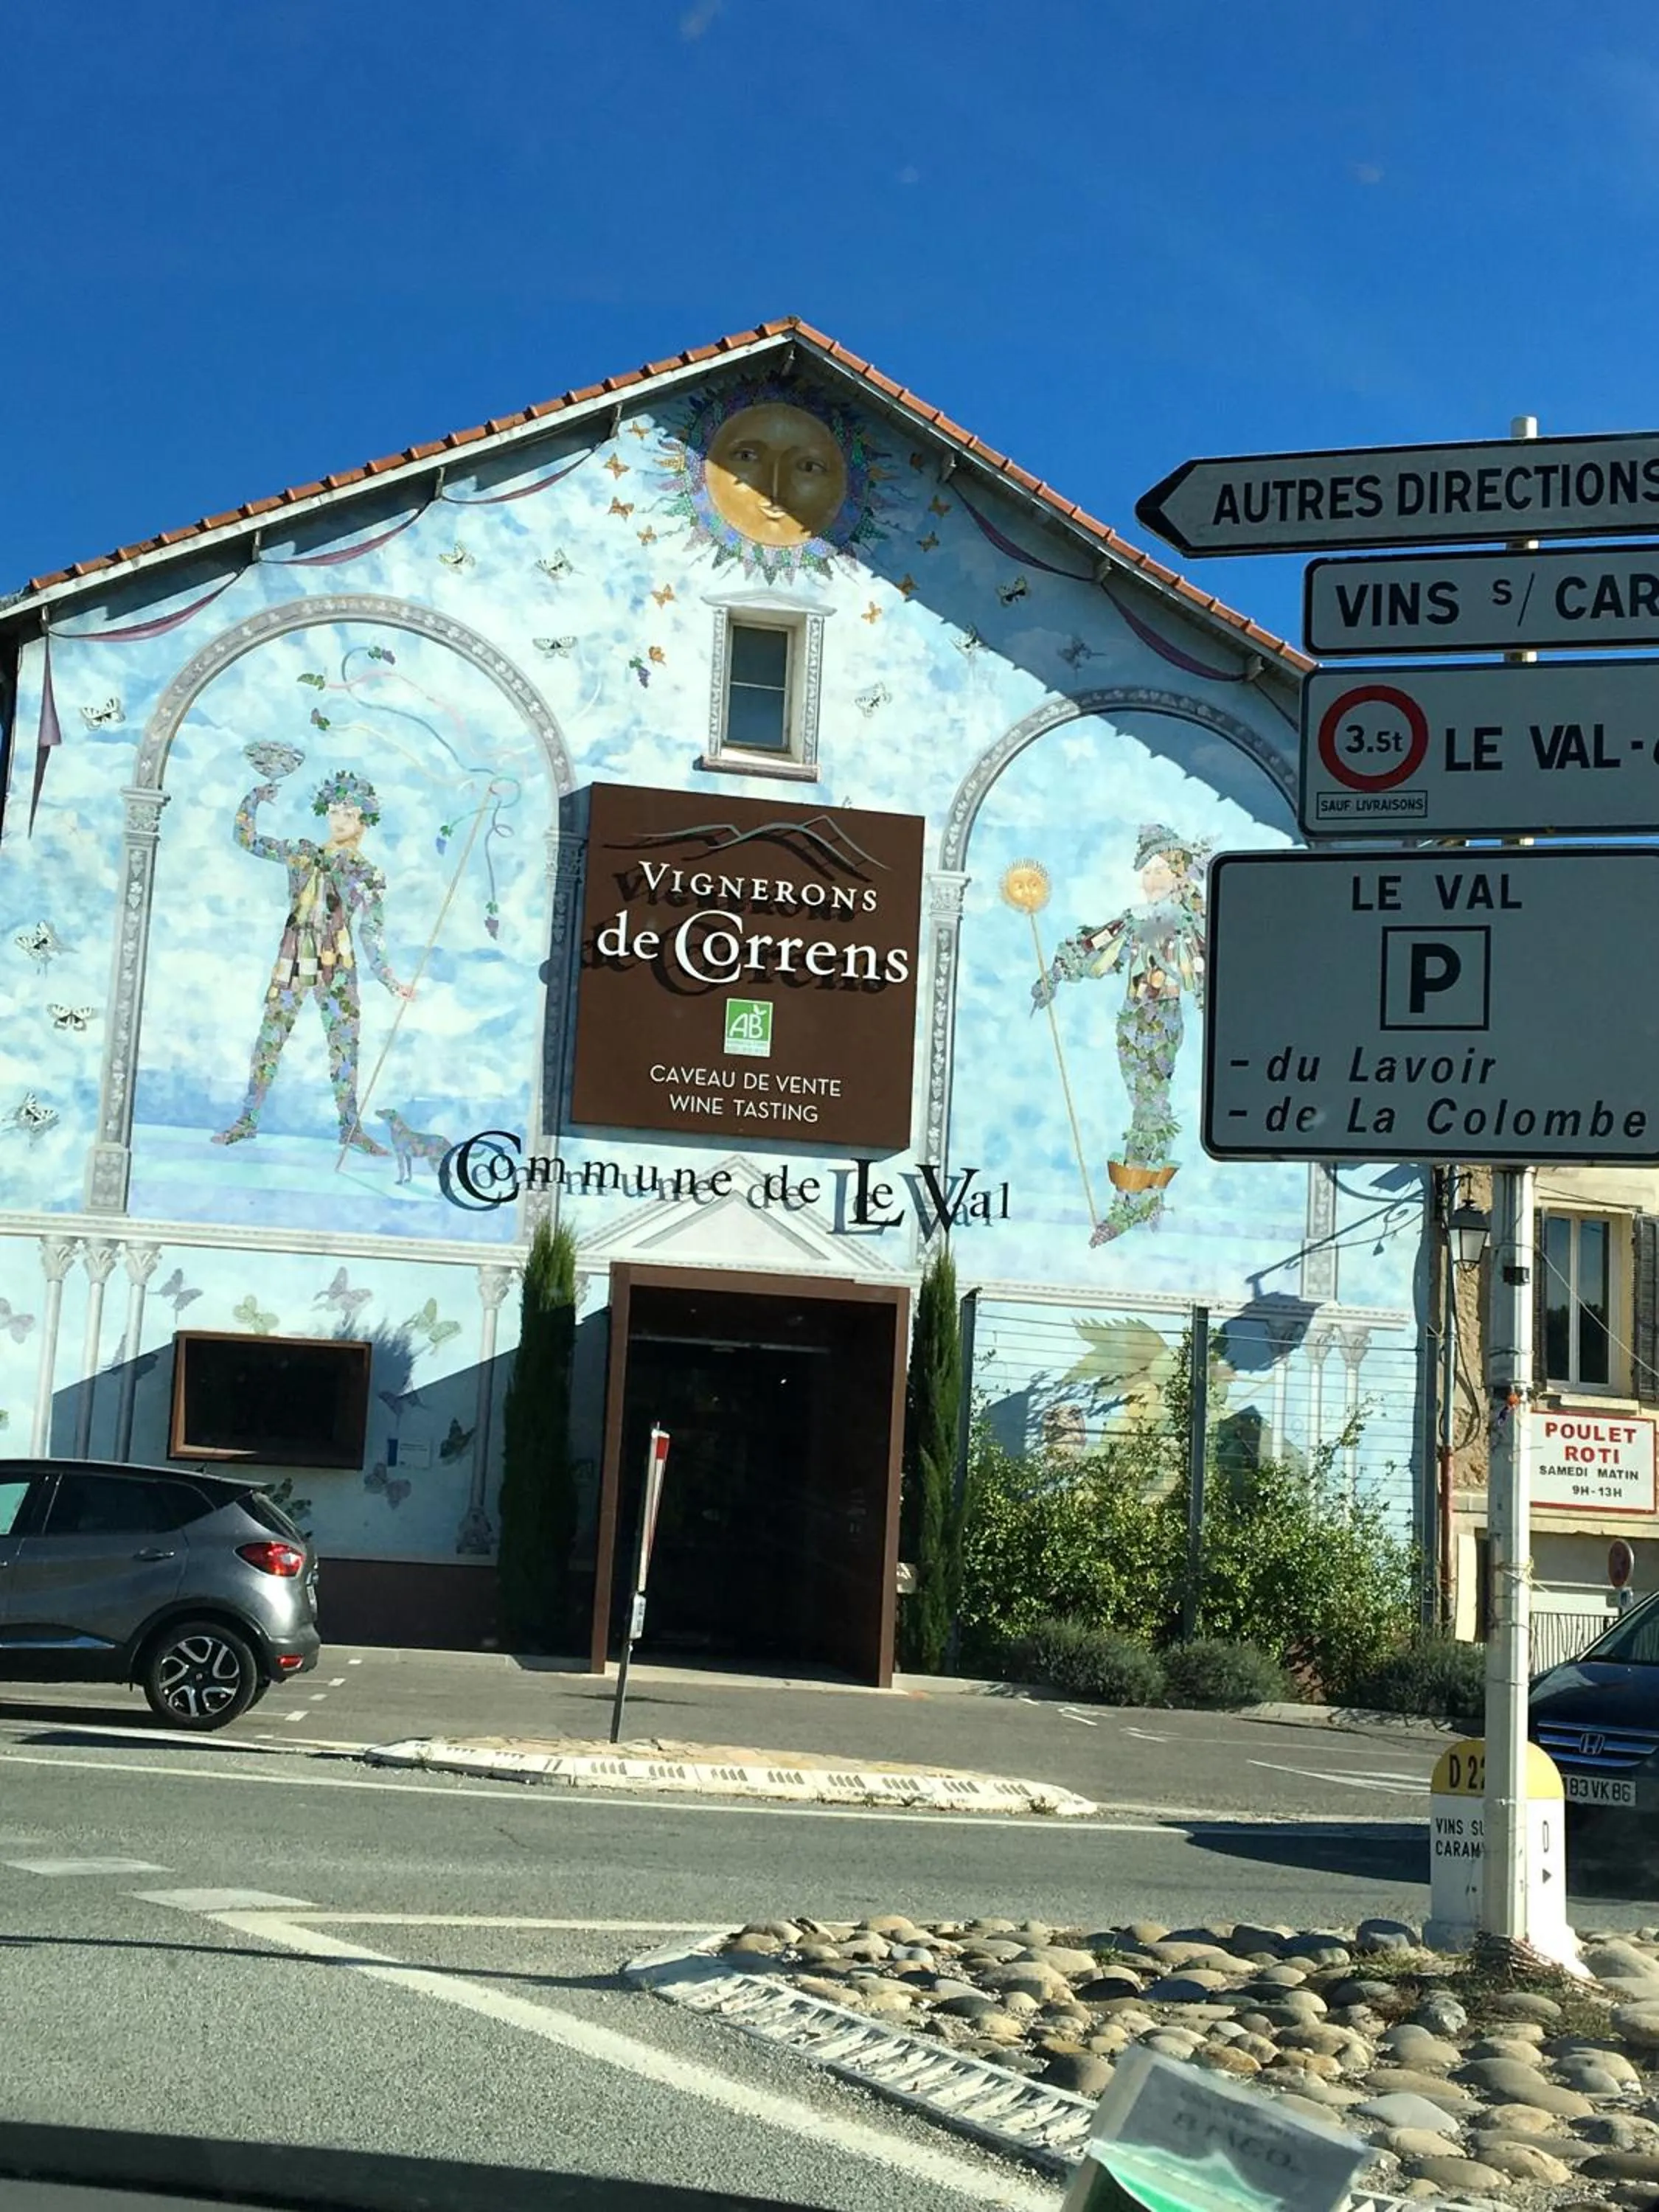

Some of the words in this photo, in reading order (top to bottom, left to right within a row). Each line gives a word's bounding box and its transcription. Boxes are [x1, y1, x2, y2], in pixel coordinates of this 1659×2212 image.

[1213, 475, 1382, 525] AUTRES
[1398, 459, 1659, 515] DIRECTIONS
[1336, 581, 1459, 627] VINS
[1345, 723, 1403, 754] 3.5t
[1444, 726, 1503, 772] LE
[1321, 799, 1352, 812] SAUF
[1356, 798, 1424, 812] LIVRAISONS
[638, 860, 878, 911] VIGNERONS
[1352, 875, 1402, 911] LE
[1435, 873, 1523, 910] VAL
[597, 909, 660, 961] de
[675, 909, 909, 984] Correns
[1409, 942, 1461, 1014] P
[728, 1012, 763, 1039] AB
[650, 1065, 736, 1089] CAVEAU
[743, 1073, 770, 1092] DE
[775, 1075, 842, 1098] VENTE
[1266, 1046, 1321, 1083] du
[1349, 1046, 1497, 1085] Lavoir
[669, 1094, 723, 1116] WINE
[733, 1099, 818, 1123] TASTING
[1266, 1096, 1317, 1133] de
[1347, 1097, 1396, 1134] La
[1427, 1098, 1647, 1138] Colombe
[456, 1130, 732, 1205] Commune
[763, 1164, 821, 1204] de
[849, 1157, 903, 1225] Le
[914, 1163, 1010, 1234] Val
[1545, 1422, 1637, 1444] POULET
[1539, 1465, 1587, 1477] SAMEDI
[1597, 1468, 1639, 1481] MATIN
[1564, 1446, 1620, 1464] ROTI
[1449, 1753, 1461, 1789] D
[1436, 1817, 1464, 1835] VINS
